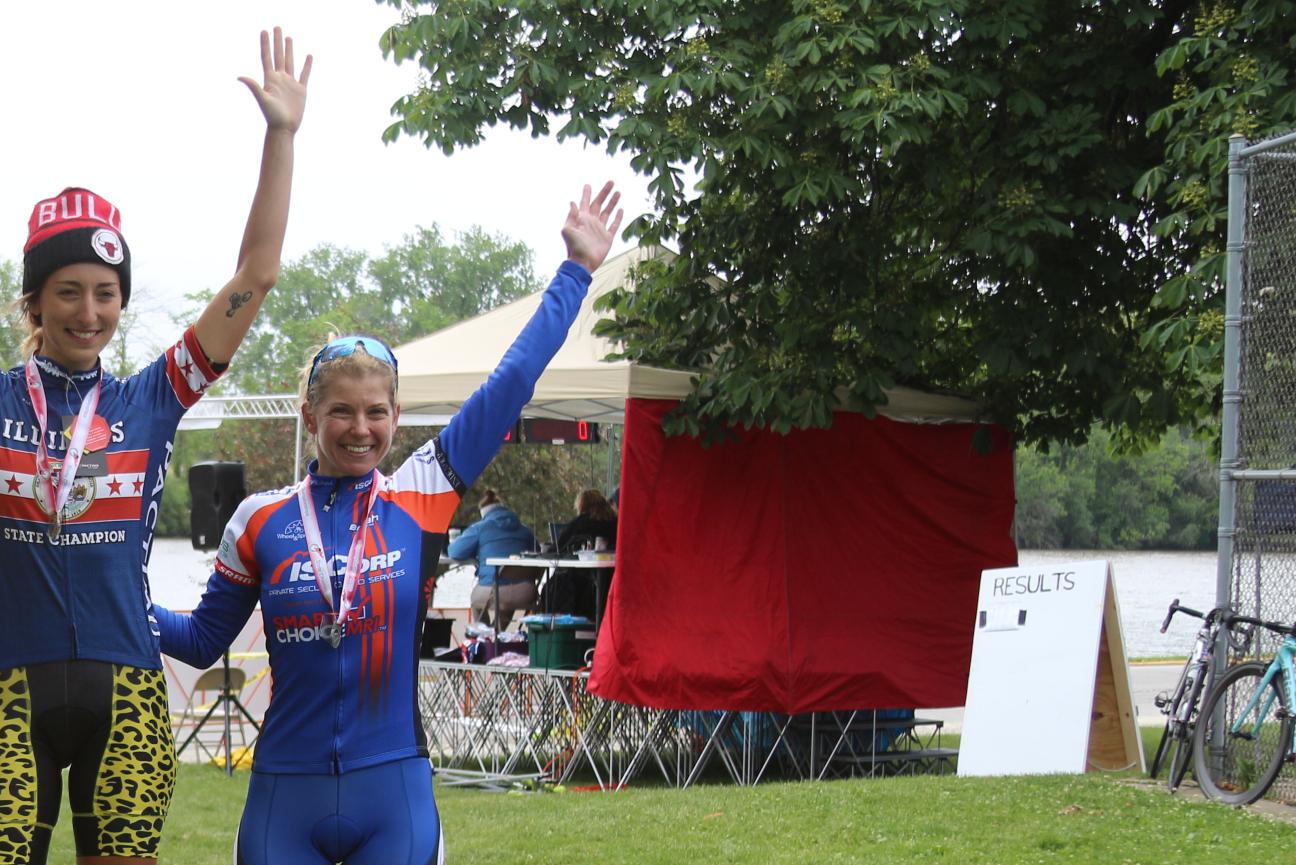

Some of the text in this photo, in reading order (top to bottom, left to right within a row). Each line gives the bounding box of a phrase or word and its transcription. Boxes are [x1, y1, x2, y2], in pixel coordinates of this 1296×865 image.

[3, 418, 126, 451] ILLIS
[4, 526, 126, 546] STATE CHAMPION
[368, 568, 406, 584] SERVICES
[993, 571, 1076, 597] RESULTS
